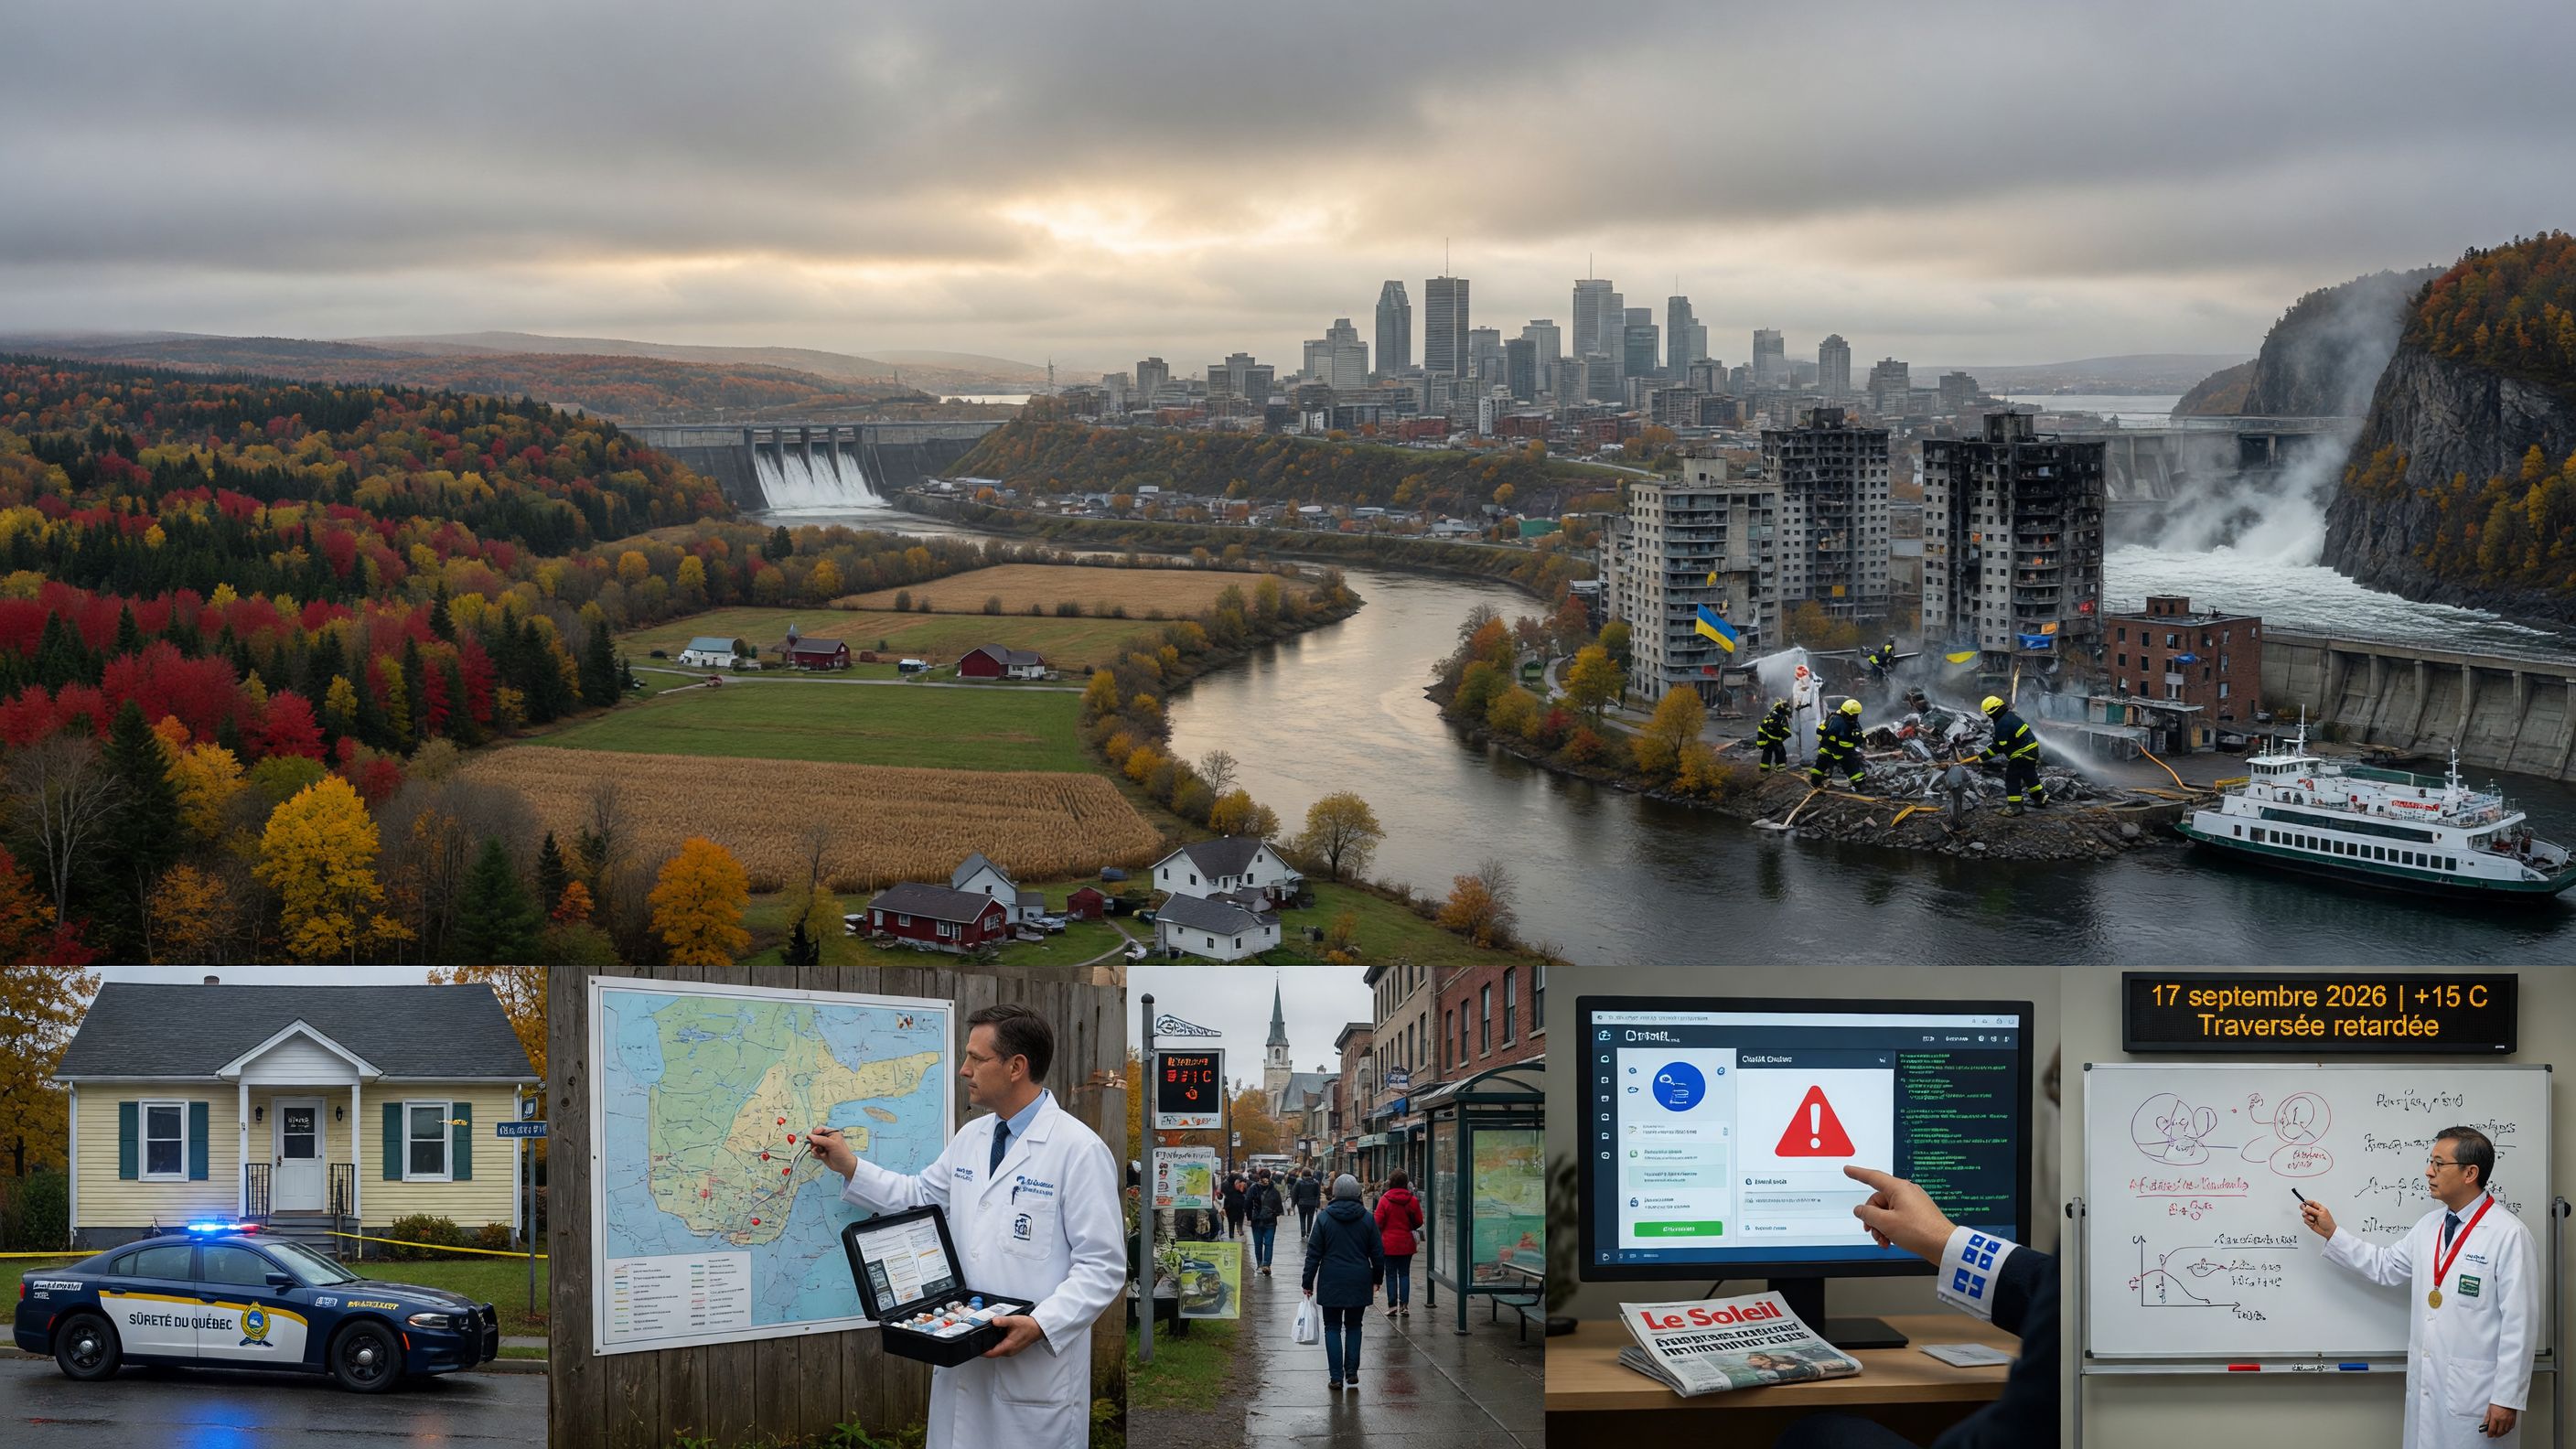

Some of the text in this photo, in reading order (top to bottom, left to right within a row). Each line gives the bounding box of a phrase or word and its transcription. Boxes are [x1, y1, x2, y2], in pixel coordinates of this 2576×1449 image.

[2152, 984, 2181, 1006] 17
[2188, 984, 2318, 1012] septembre
[2325, 984, 2388, 1007] 2026
[2414, 984, 2461, 1008] +15
[2468, 984, 2488, 1008] C
[2197, 1013, 2440, 1037] Traversée retardée
[129, 1311, 172, 1327] SÛRETÉ
[174, 1316, 189, 1328] DU
[1640, 1301, 1783, 1330] Le Soleil
